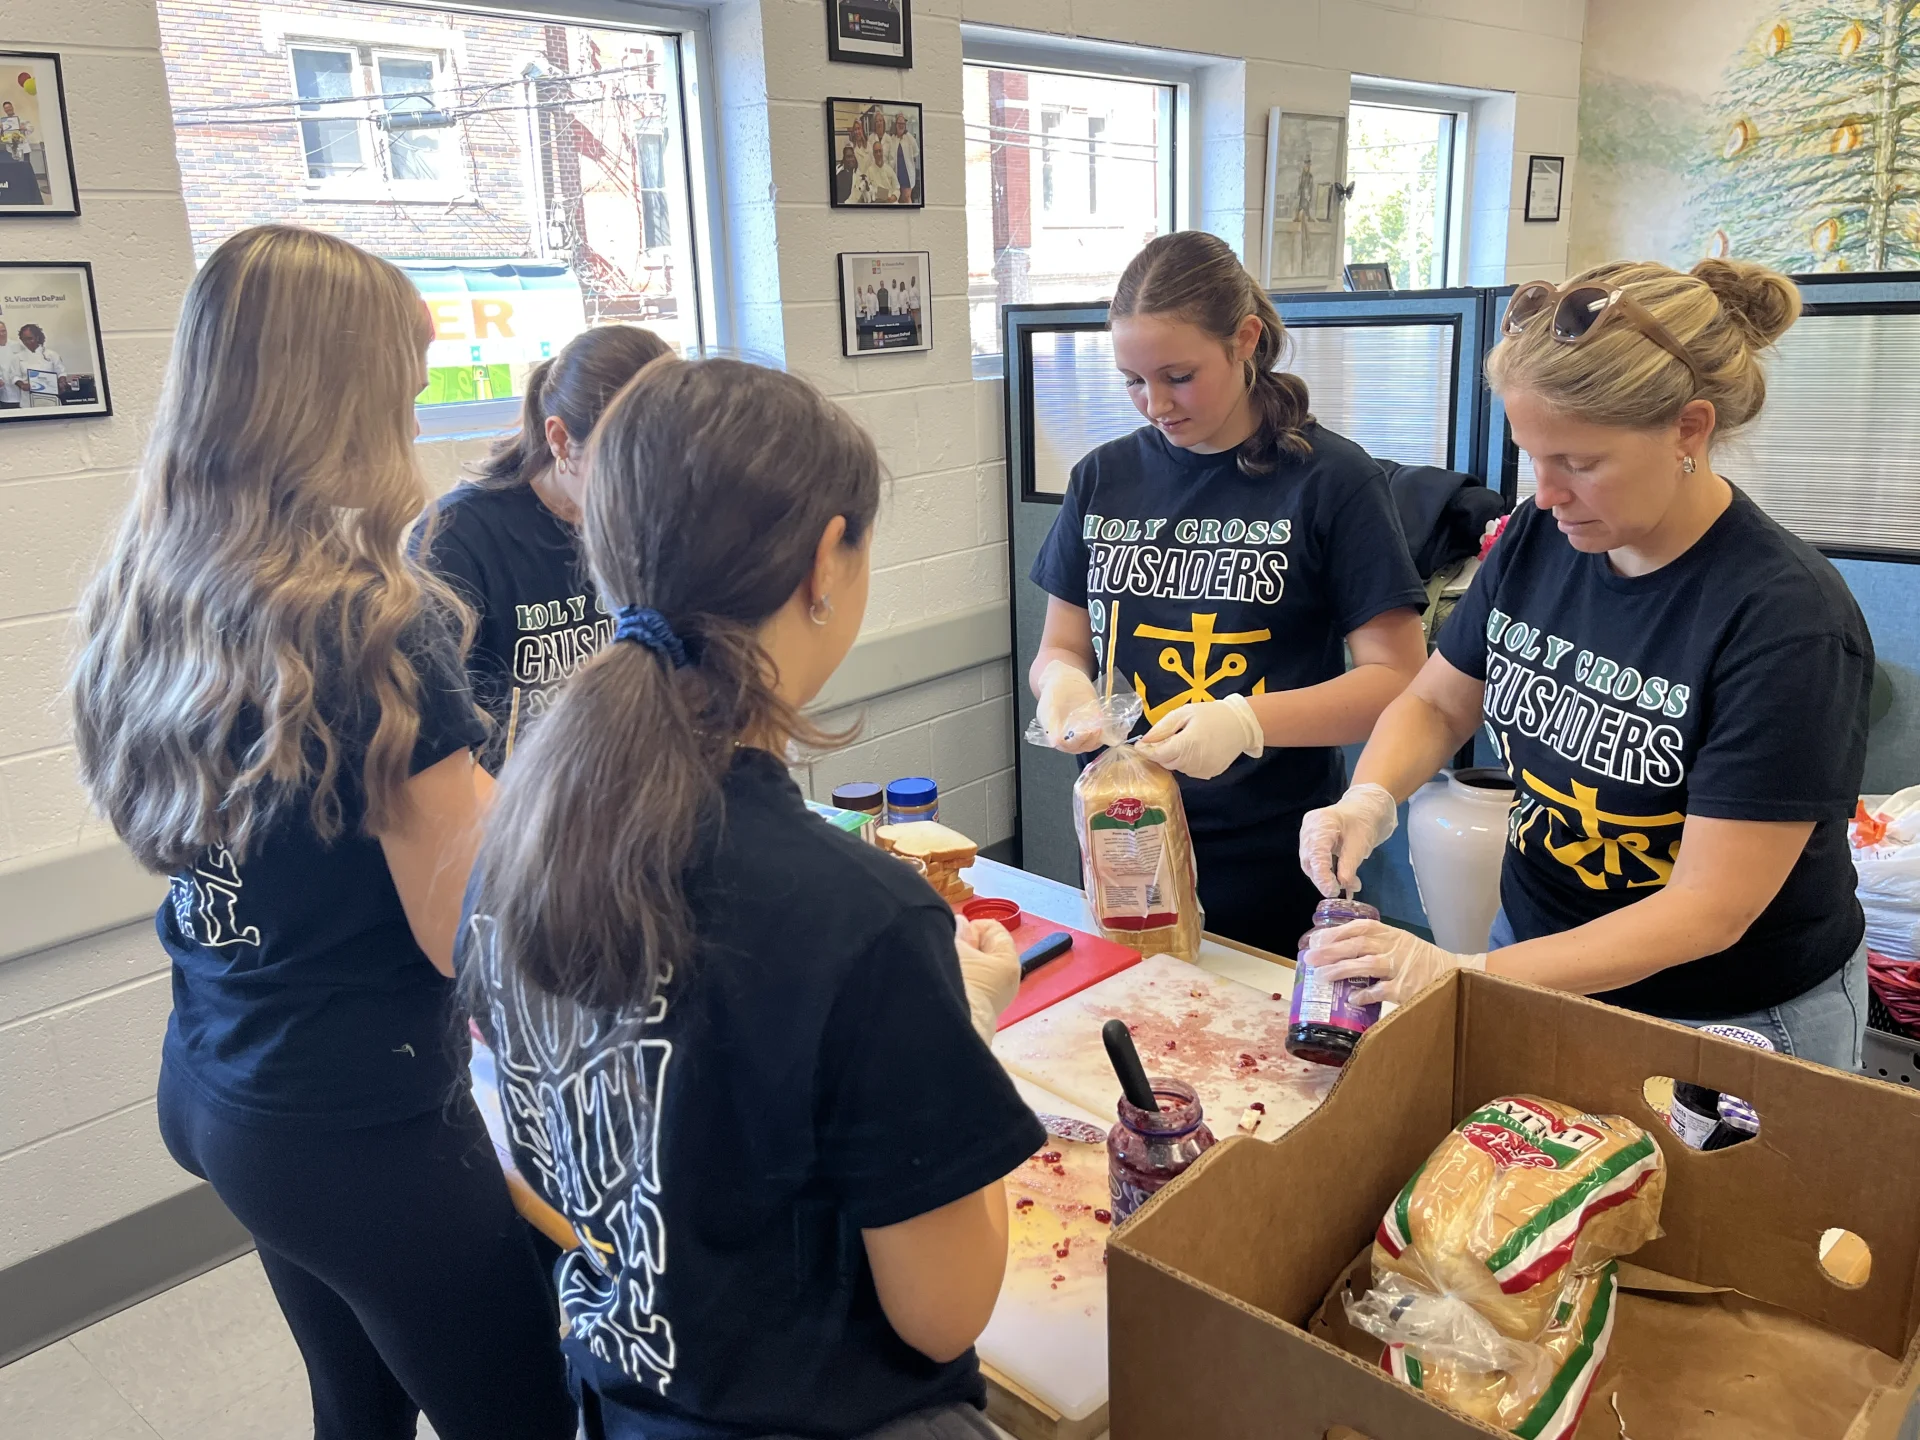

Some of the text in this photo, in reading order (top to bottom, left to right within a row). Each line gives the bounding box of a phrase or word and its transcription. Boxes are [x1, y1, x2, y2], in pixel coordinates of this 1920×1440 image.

[425, 299, 516, 340] ER
[1083, 514, 1291, 544] HOLY CROSS
[515, 595, 586, 630] HOLY
[513, 618, 617, 684] CRUSA
[1486, 607, 1690, 719] HOLY CROSS
[1483, 645, 1684, 788] RUSADERS
